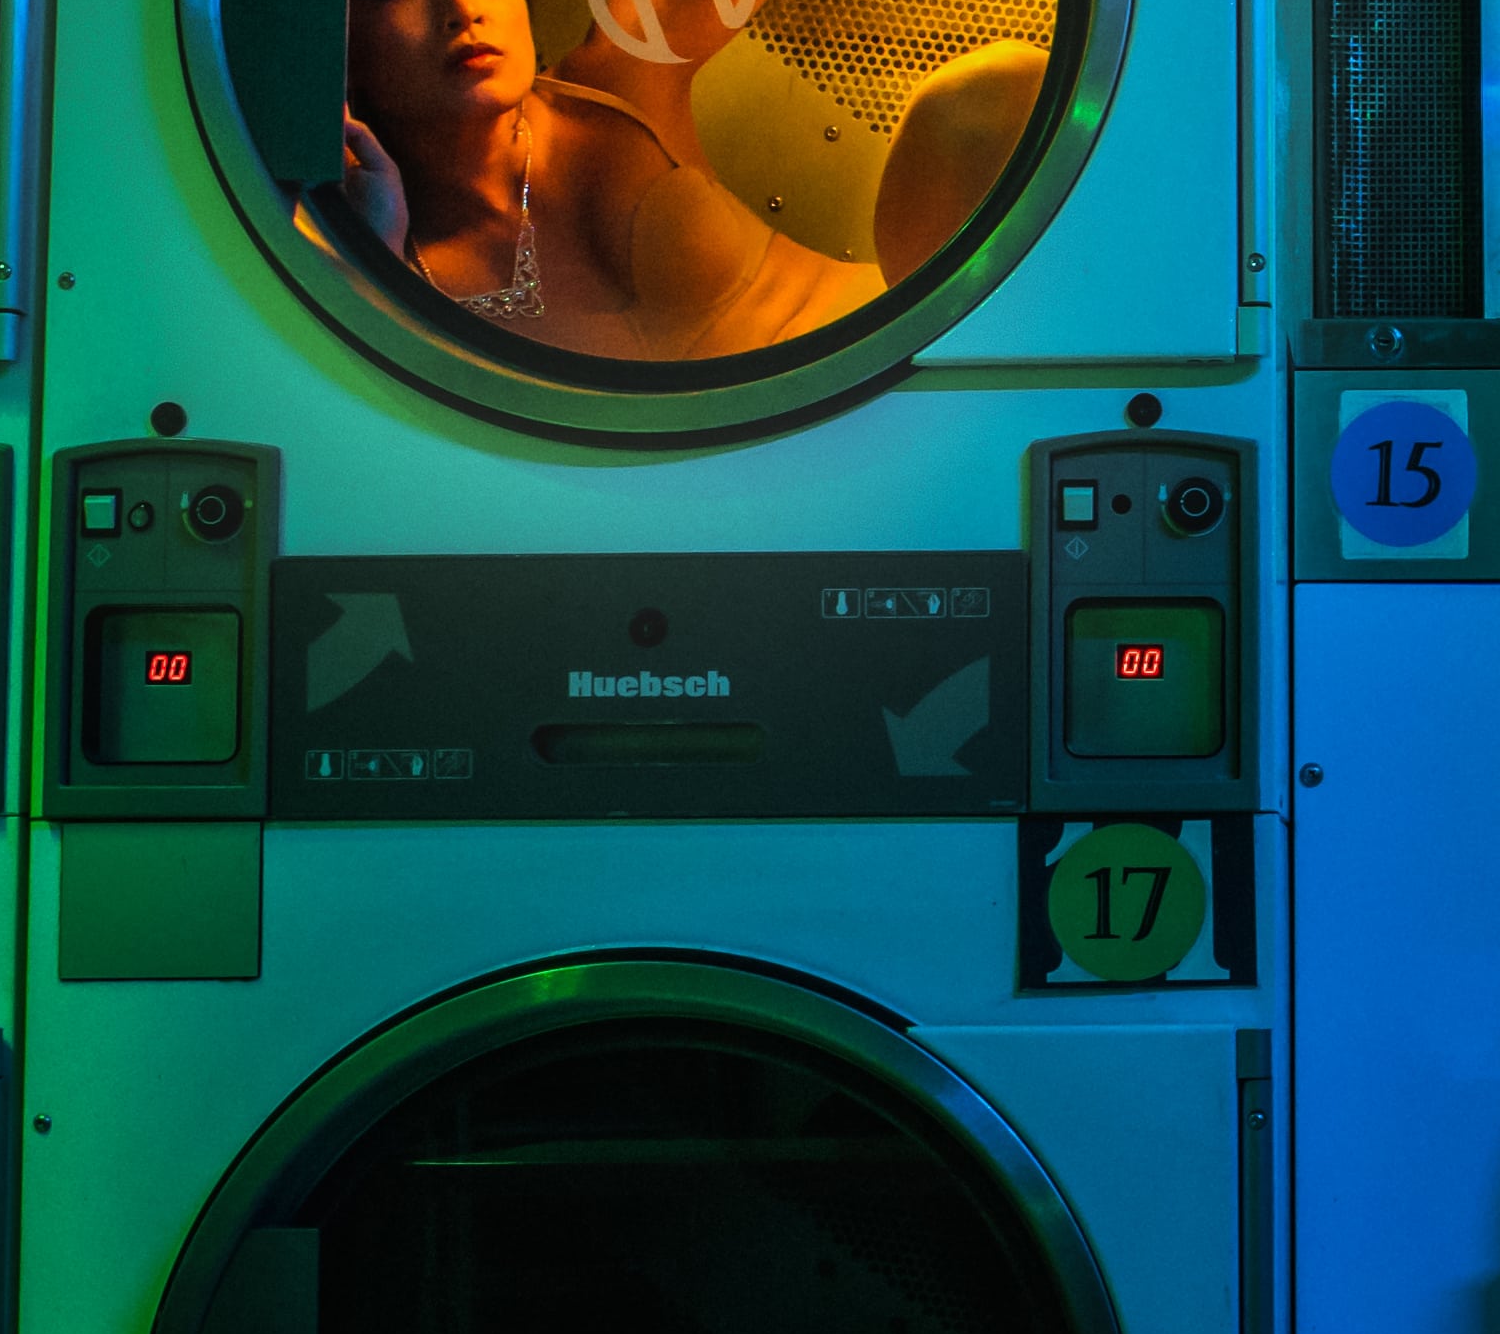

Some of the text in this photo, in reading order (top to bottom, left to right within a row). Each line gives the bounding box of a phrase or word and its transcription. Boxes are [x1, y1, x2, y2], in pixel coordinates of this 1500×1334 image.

[1364, 437, 1446, 509] 15
[146, 653, 189, 683] 00
[1119, 647, 1162, 677] 00
[567, 669, 732, 699] Huebsch
[1083, 866, 1173, 942] 17
